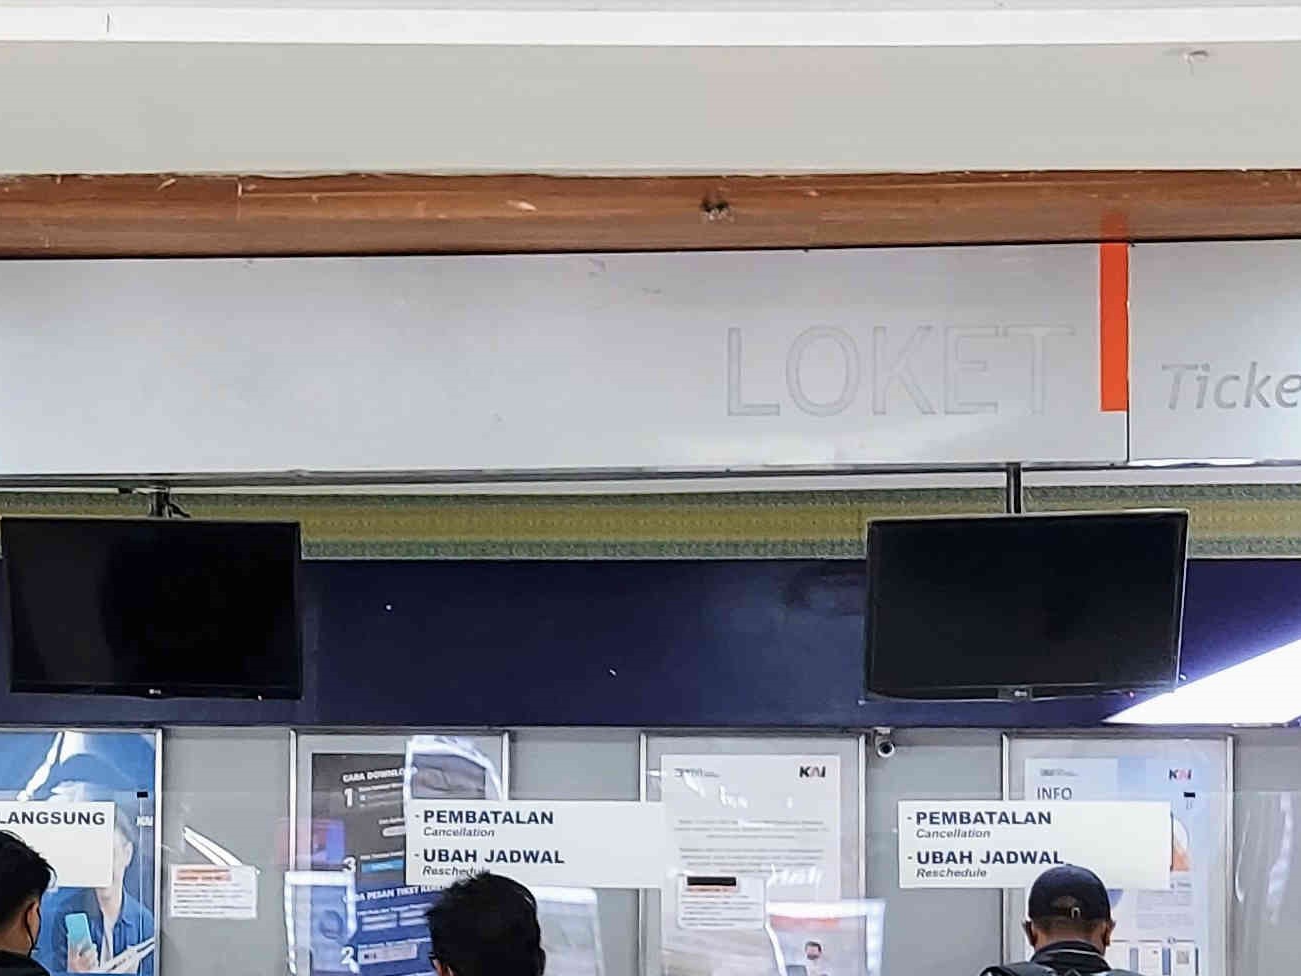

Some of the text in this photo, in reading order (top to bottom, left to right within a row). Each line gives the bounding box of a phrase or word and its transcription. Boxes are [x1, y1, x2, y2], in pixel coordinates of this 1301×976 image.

[726, 323, 1076, 416] LOKET
[1161, 360, 1301, 410] Ticke
[798, 765, 826, 778] KAI
[1168, 768, 1192, 780] KAI
[1036, 787, 1073, 801] INFO
[423, 810, 554, 825] PEMBATALAN
[916, 811, 1052, 825] PEMBATALAN
[423, 826, 496, 838] Cancellation
[916, 828, 992, 839] Cancellation
[423, 849, 565, 864] UBAH JADWAL
[917, 851, 1065, 865] UBAH JADWAL
[916, 868, 987, 878] Reschedule
